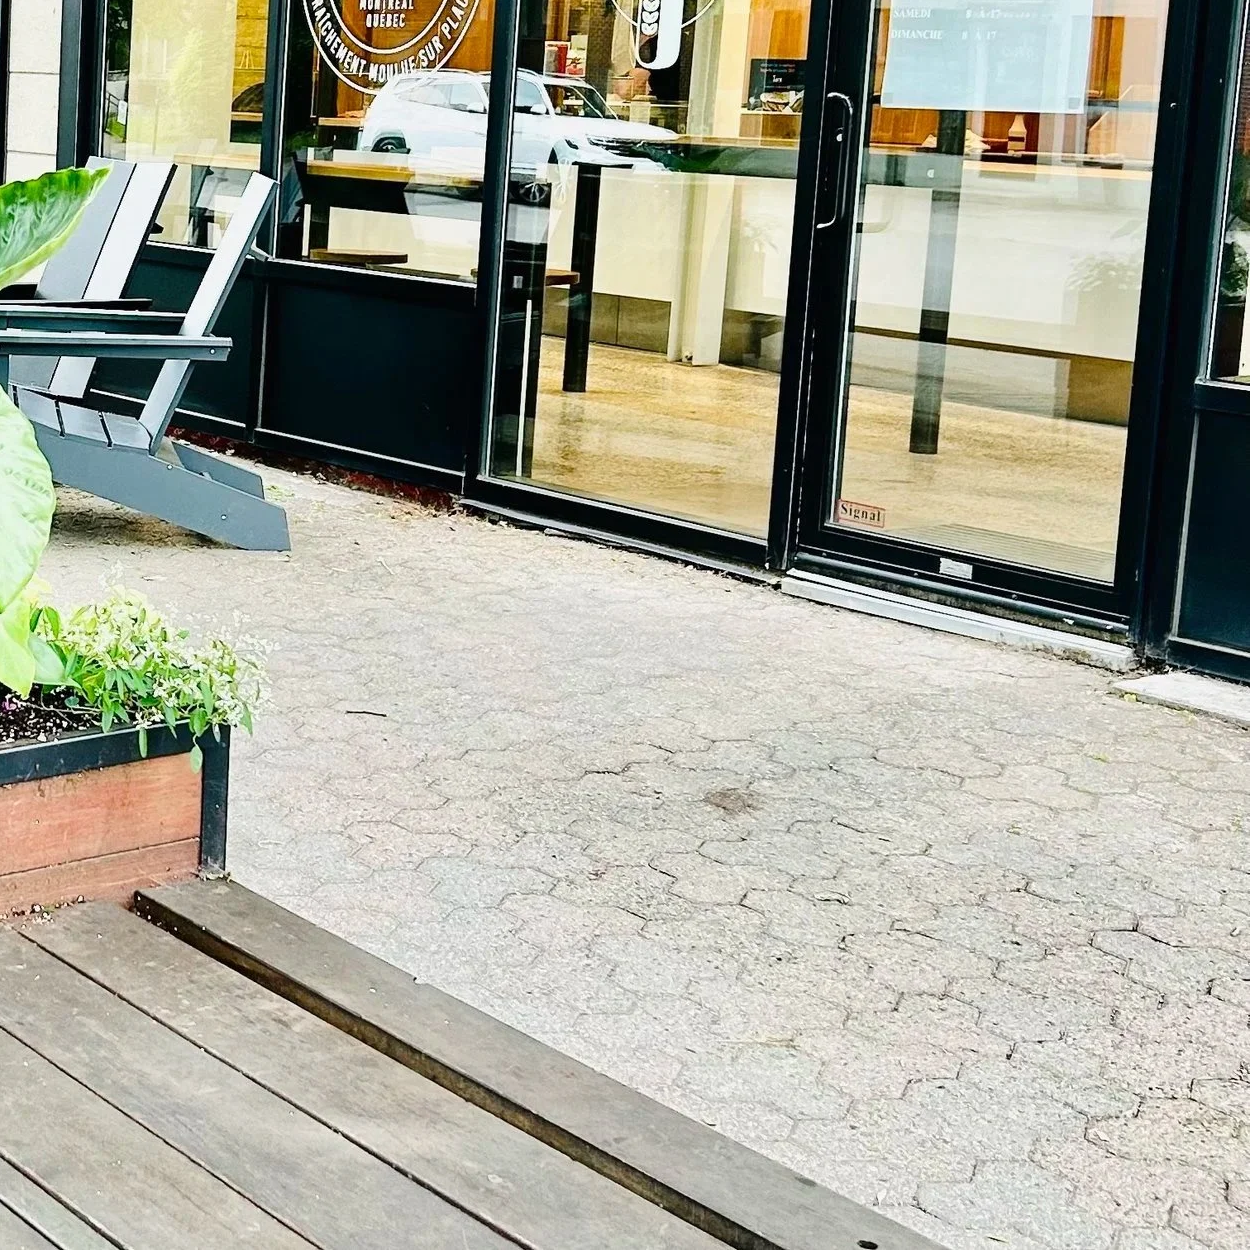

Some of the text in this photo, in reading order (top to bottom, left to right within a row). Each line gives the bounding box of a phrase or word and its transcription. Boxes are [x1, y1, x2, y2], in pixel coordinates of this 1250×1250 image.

[365, 8, 406, 28] QUÉBEC
[893, 8, 932, 19] SAMEDI
[891, 29, 943, 40] DIMANCHE
[420, 35, 444, 68] SUR
[841, 502, 881, 522] Signal
